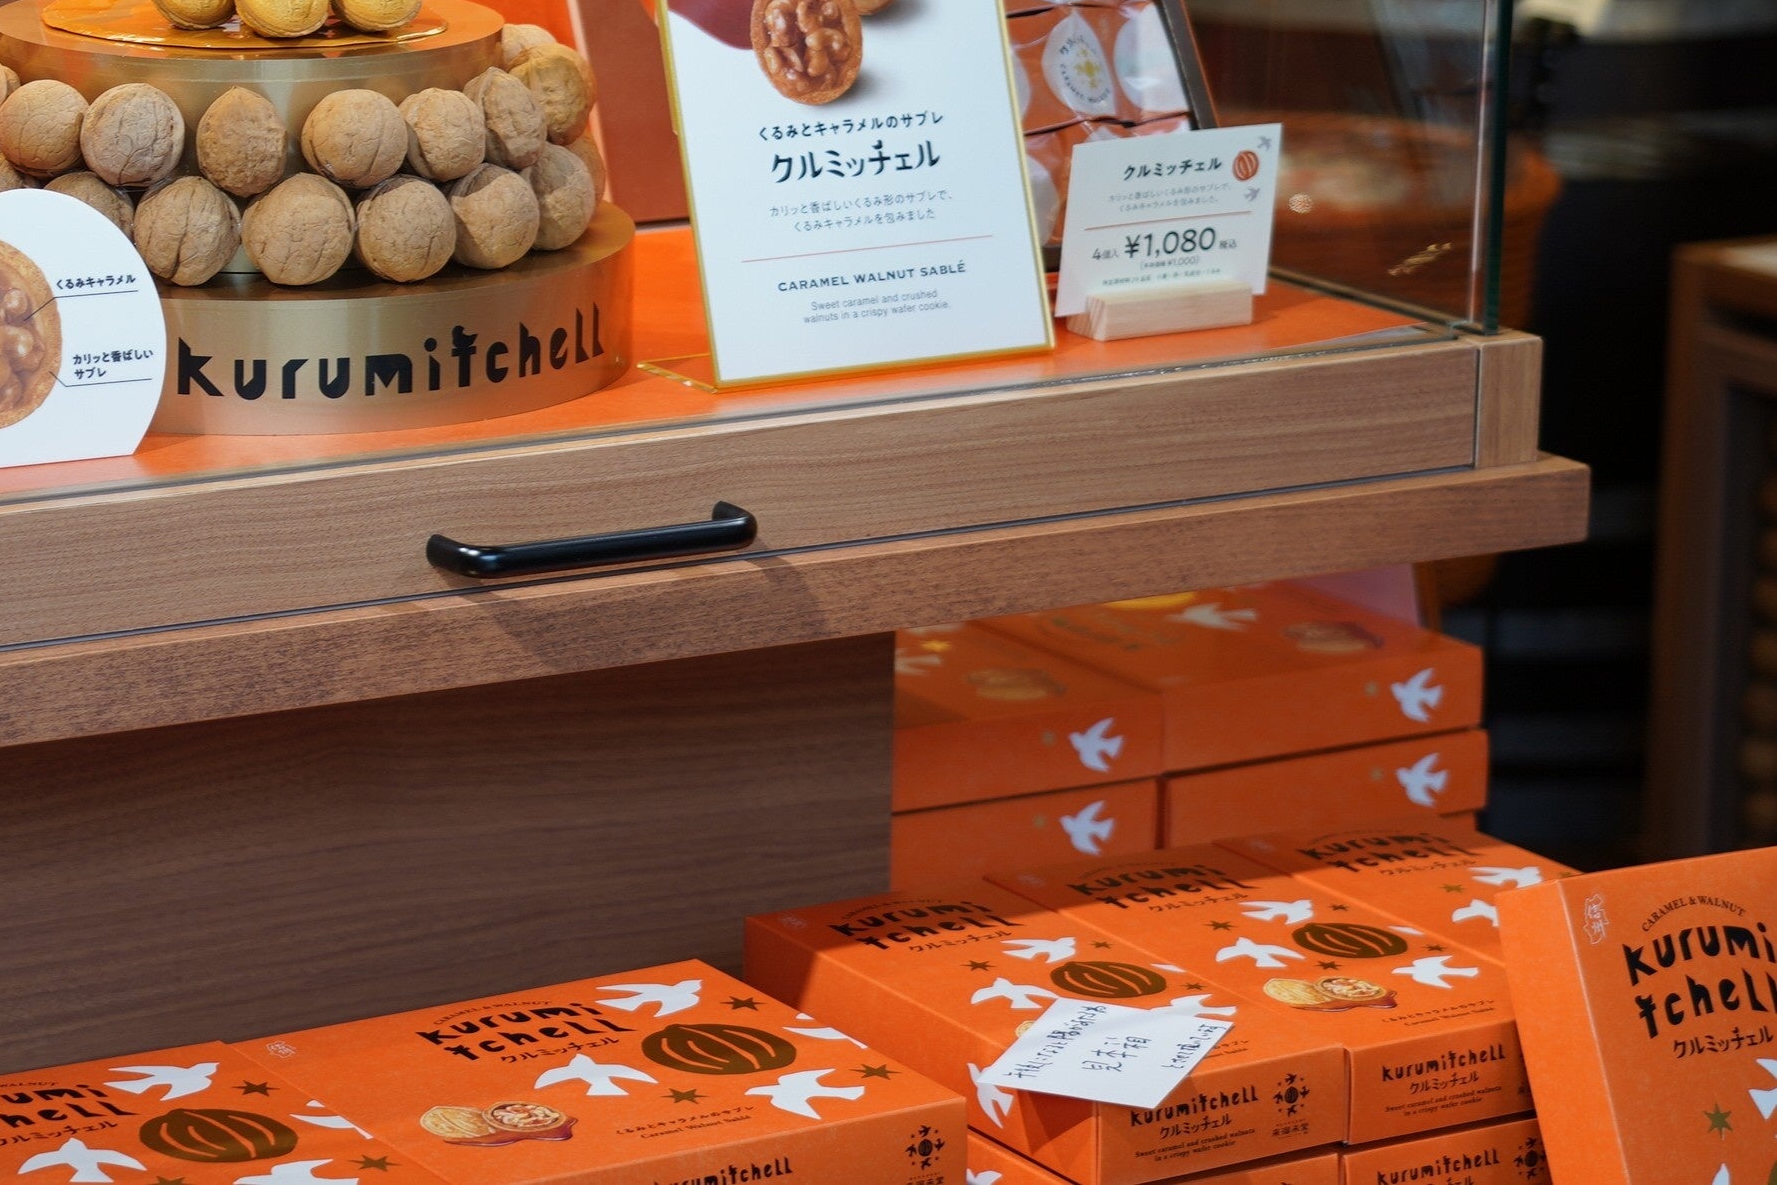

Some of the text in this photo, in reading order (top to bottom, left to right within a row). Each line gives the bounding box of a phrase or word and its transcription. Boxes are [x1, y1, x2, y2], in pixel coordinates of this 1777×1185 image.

[758, 110, 943, 141] くるみとキャラメルのサブレ
[771, 139, 941, 184] クルミッチェル
[1123, 158, 1222, 181] クルミッチェル
[1124, 227, 1216, 258] ¥1,080
[56, 275, 136, 290] くるみキャラメル
[778, 260, 966, 292] CARAMEL WALNUT SABLÉ
[804, 311, 839, 324] walnuts
[841, 310, 850, 320] in
[861, 306, 888, 319] crispy
[891, 304, 916, 314] wafer
[811, 289, 938, 311] Sweet caramel and crushed
[73, 349, 154, 366] カリッと香ばしい
[177, 301, 604, 401] kurumitchell
[74, 368, 106, 380] サブレ
[1067, 864, 1226, 896] kurumi
[827, 901, 992, 936] kurumi
[1641, 895, 1746, 932] CARAMEL & WALNUT
[909, 930, 1012, 952] クルミッチェル
[1622, 922, 1776, 987] kurumi
[415, 1003, 603, 1046] kurumi
[444, 1018, 638, 1061] tchell
[501, 1037, 620, 1064] クルミッチェル
[1081, 1036, 1152, 1072] 見本箱
[1673, 1025, 1774, 1059] クルミッチェル
[1382, 1044, 1505, 1082] kurumitchell
[1409, 1070, 1479, 1095] クルミッチェル
[1131, 1086, 1259, 1126] kurumitchell
[1160, 1113, 1232, 1140] クルミッチェル
[1377, 1148, 1500, 1185] kurumitchell
